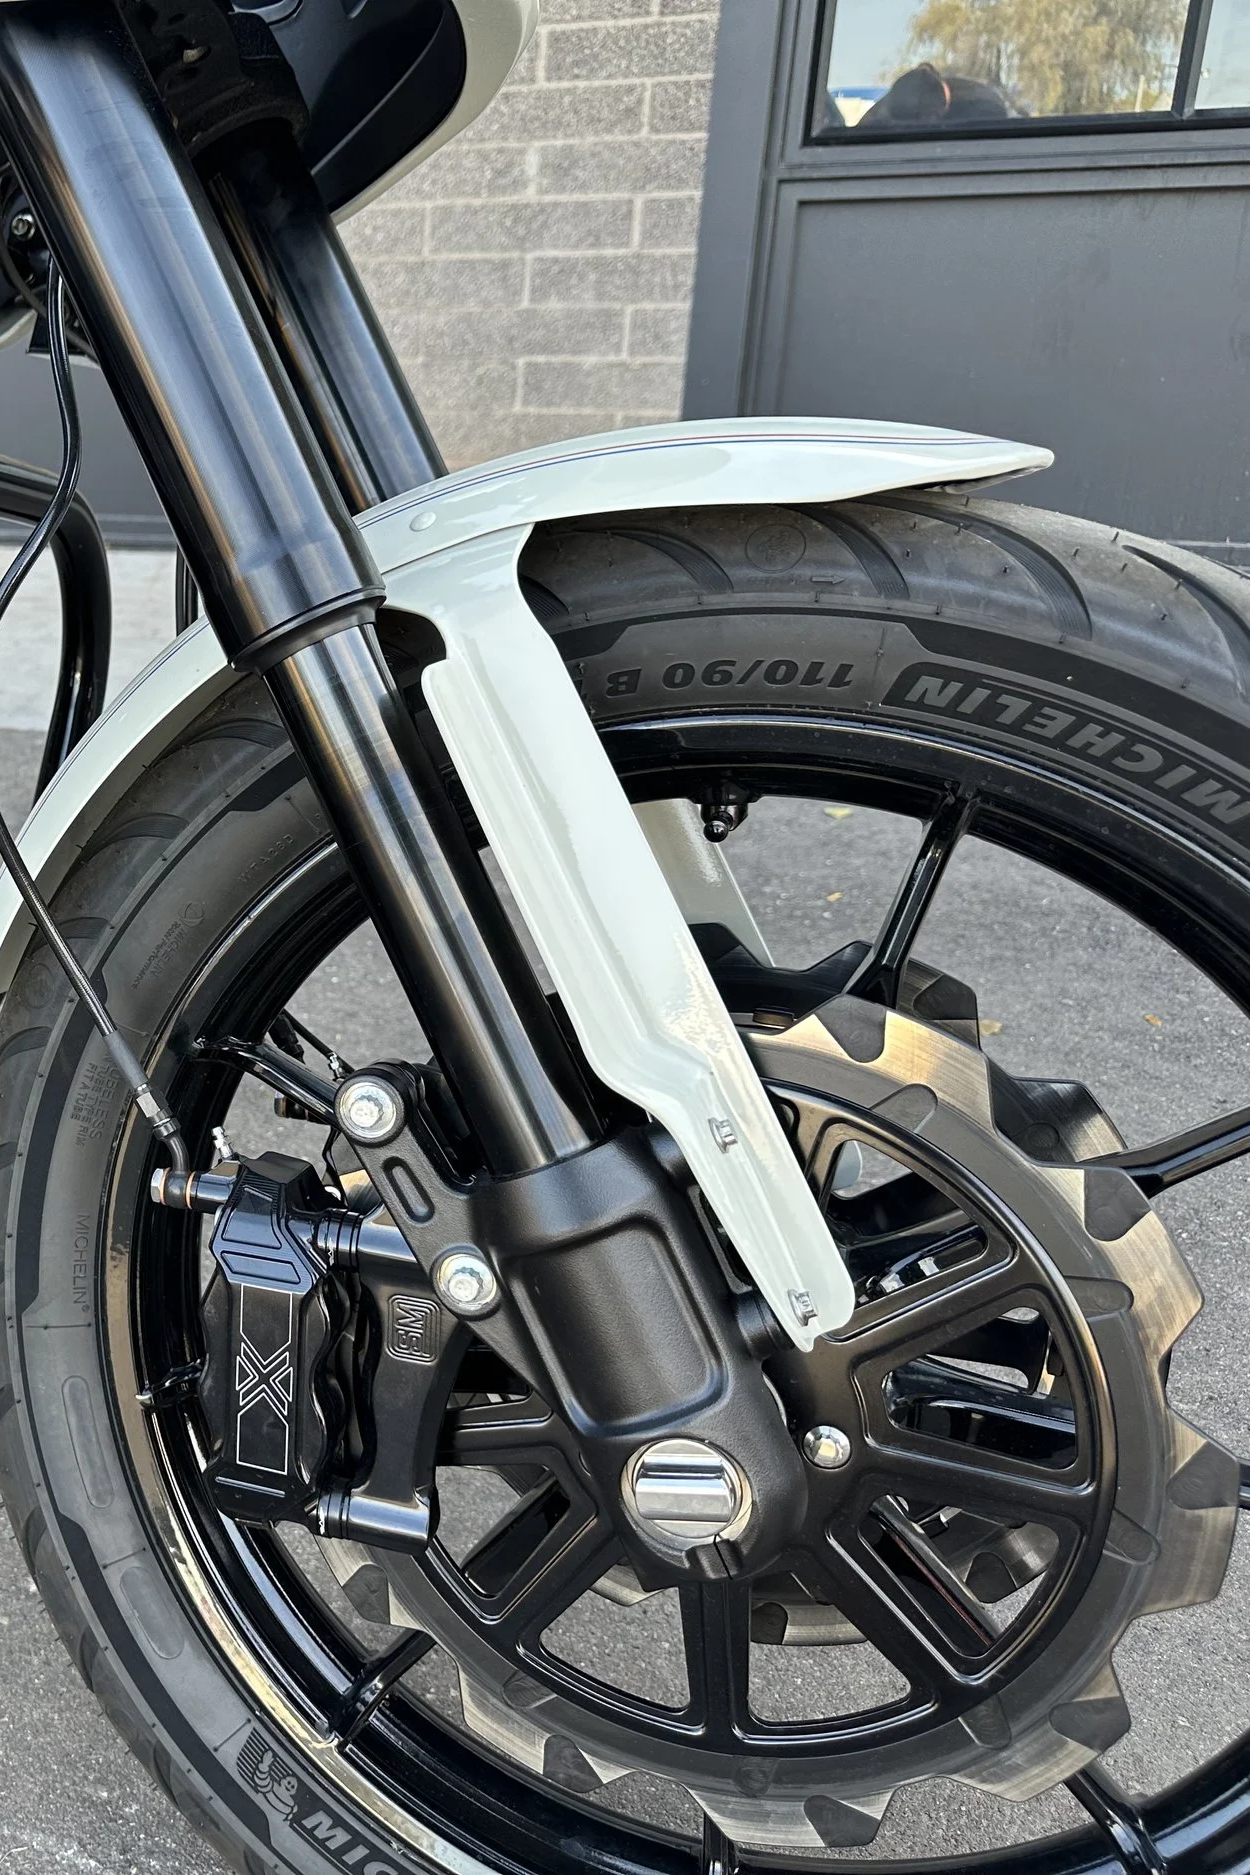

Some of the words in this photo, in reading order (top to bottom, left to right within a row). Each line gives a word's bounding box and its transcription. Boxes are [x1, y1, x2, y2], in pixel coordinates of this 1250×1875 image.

[605, 666, 643, 698] B
[662, 659, 854, 690] 110/90
[904, 674, 1250, 825] MICHELIN
[88, 1063, 122, 1140] UBELESS
